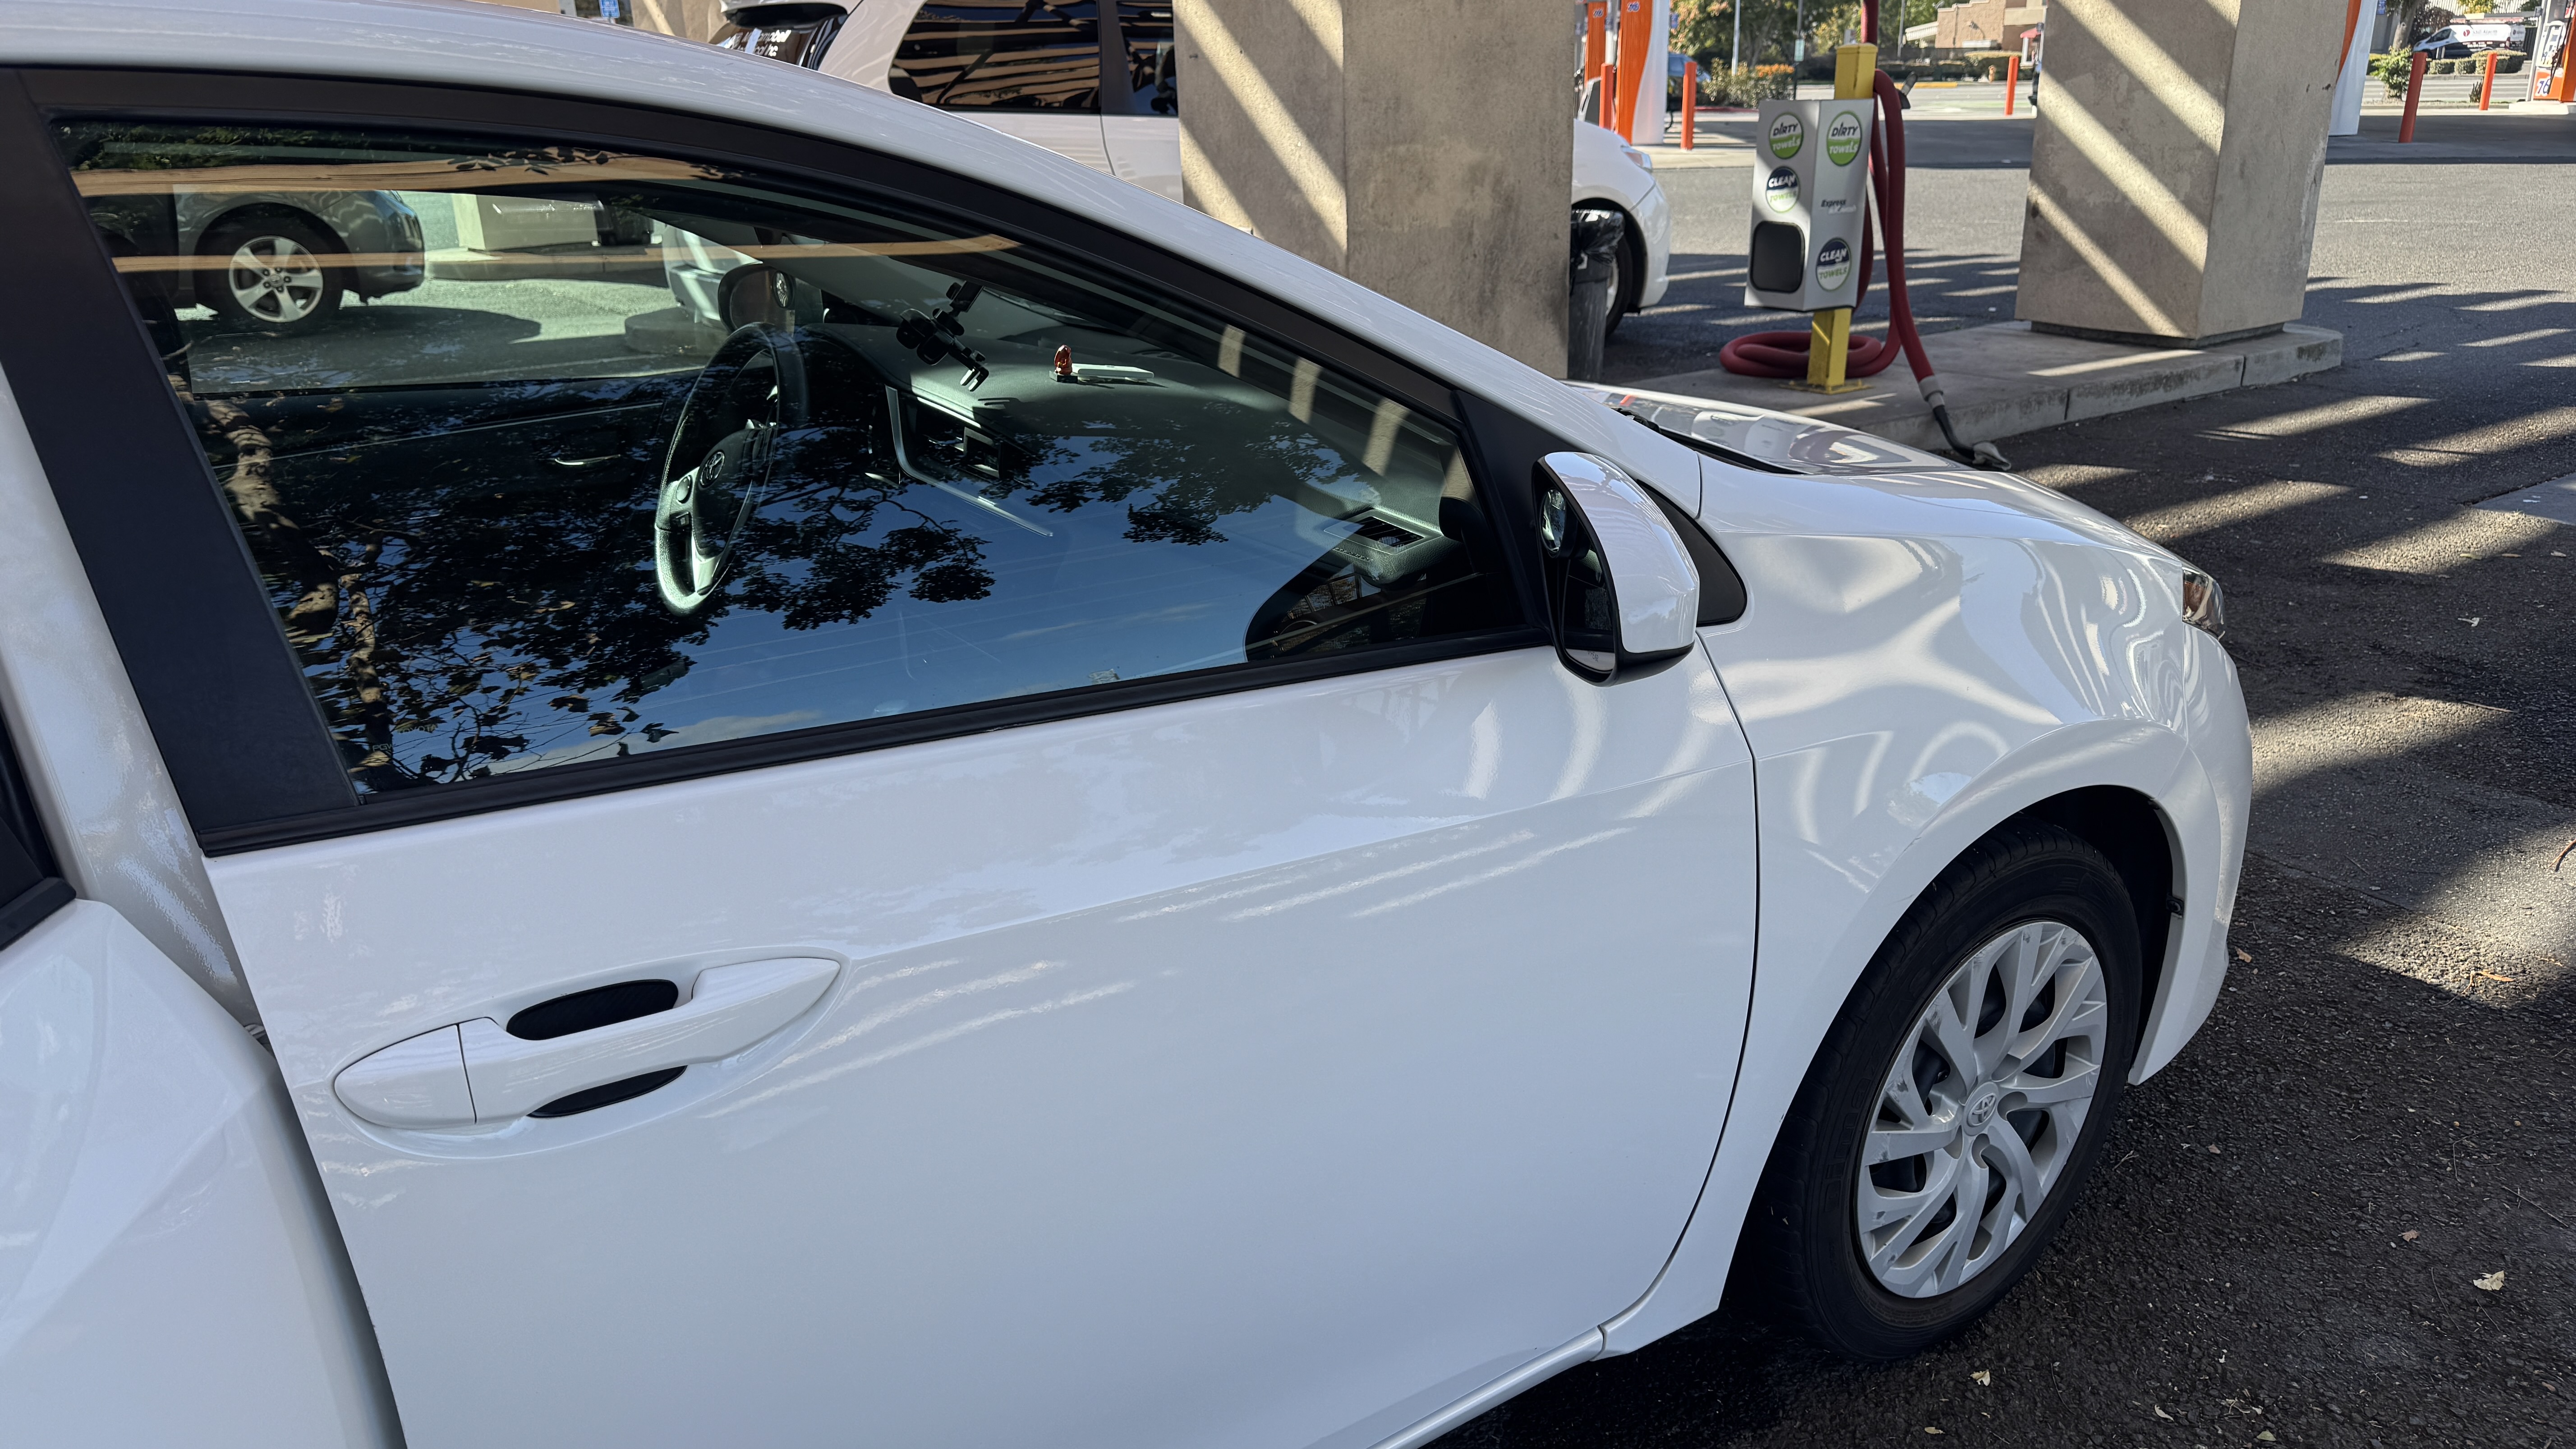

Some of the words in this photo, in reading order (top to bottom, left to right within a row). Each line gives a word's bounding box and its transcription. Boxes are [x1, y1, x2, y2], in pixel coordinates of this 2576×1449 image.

[1831, 121, 1858, 137] DIRTY
[1768, 175, 1796, 188] CLEAN
[1820, 248, 1847, 262] CLEAN
[1819, 267, 1847, 280] TOWELS
